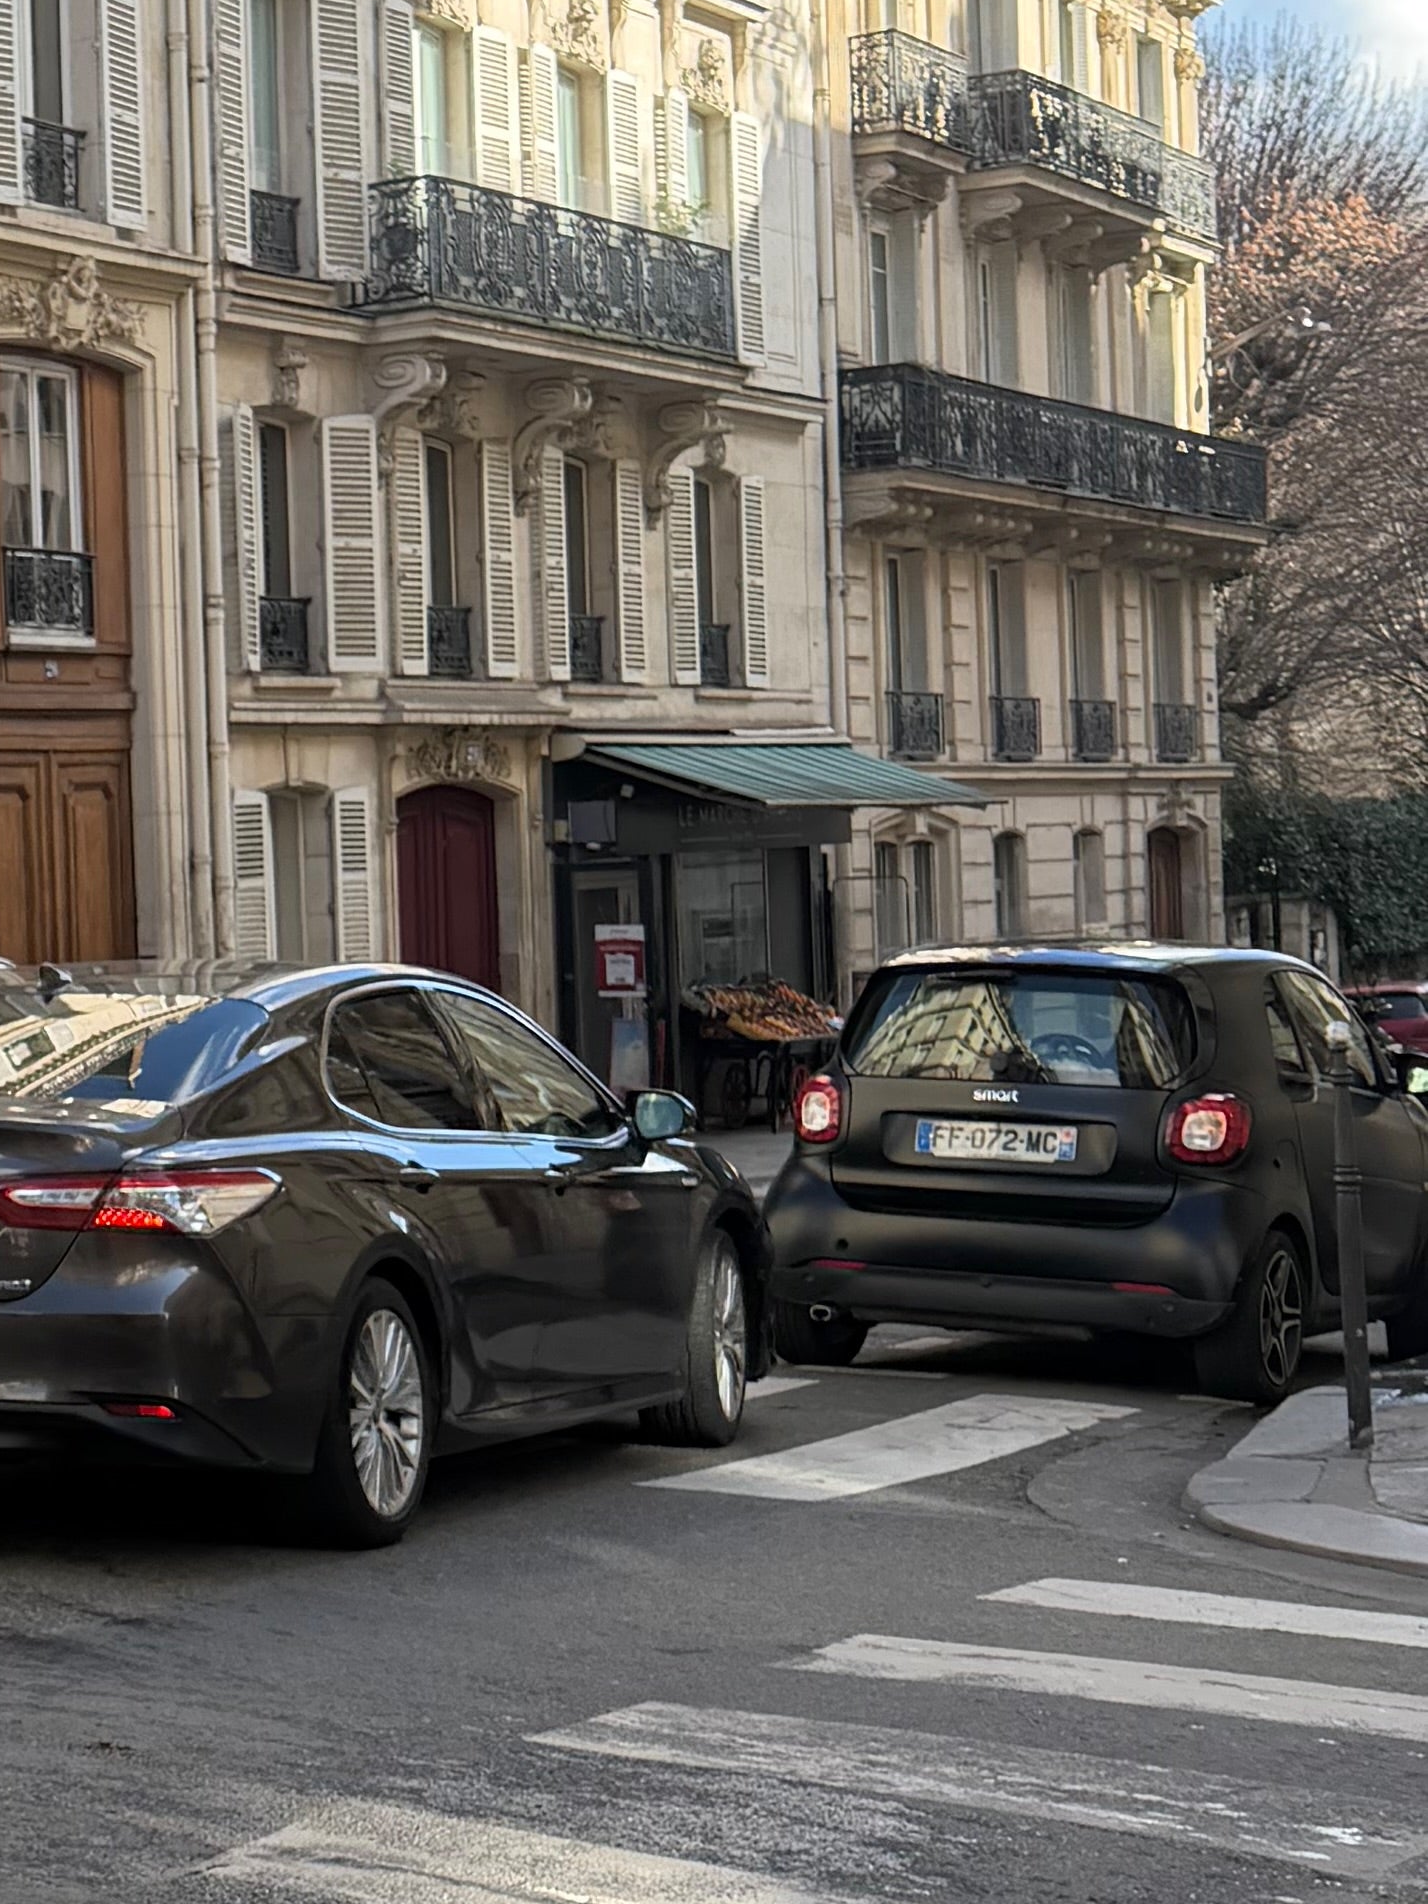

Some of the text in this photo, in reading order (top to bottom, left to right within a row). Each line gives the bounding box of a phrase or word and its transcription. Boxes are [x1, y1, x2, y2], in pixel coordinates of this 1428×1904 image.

[678, 805, 694, 827] LE
[973, 1089, 1020, 1103] smart
[932, 1125, 1058, 1154] FF-072-MC
